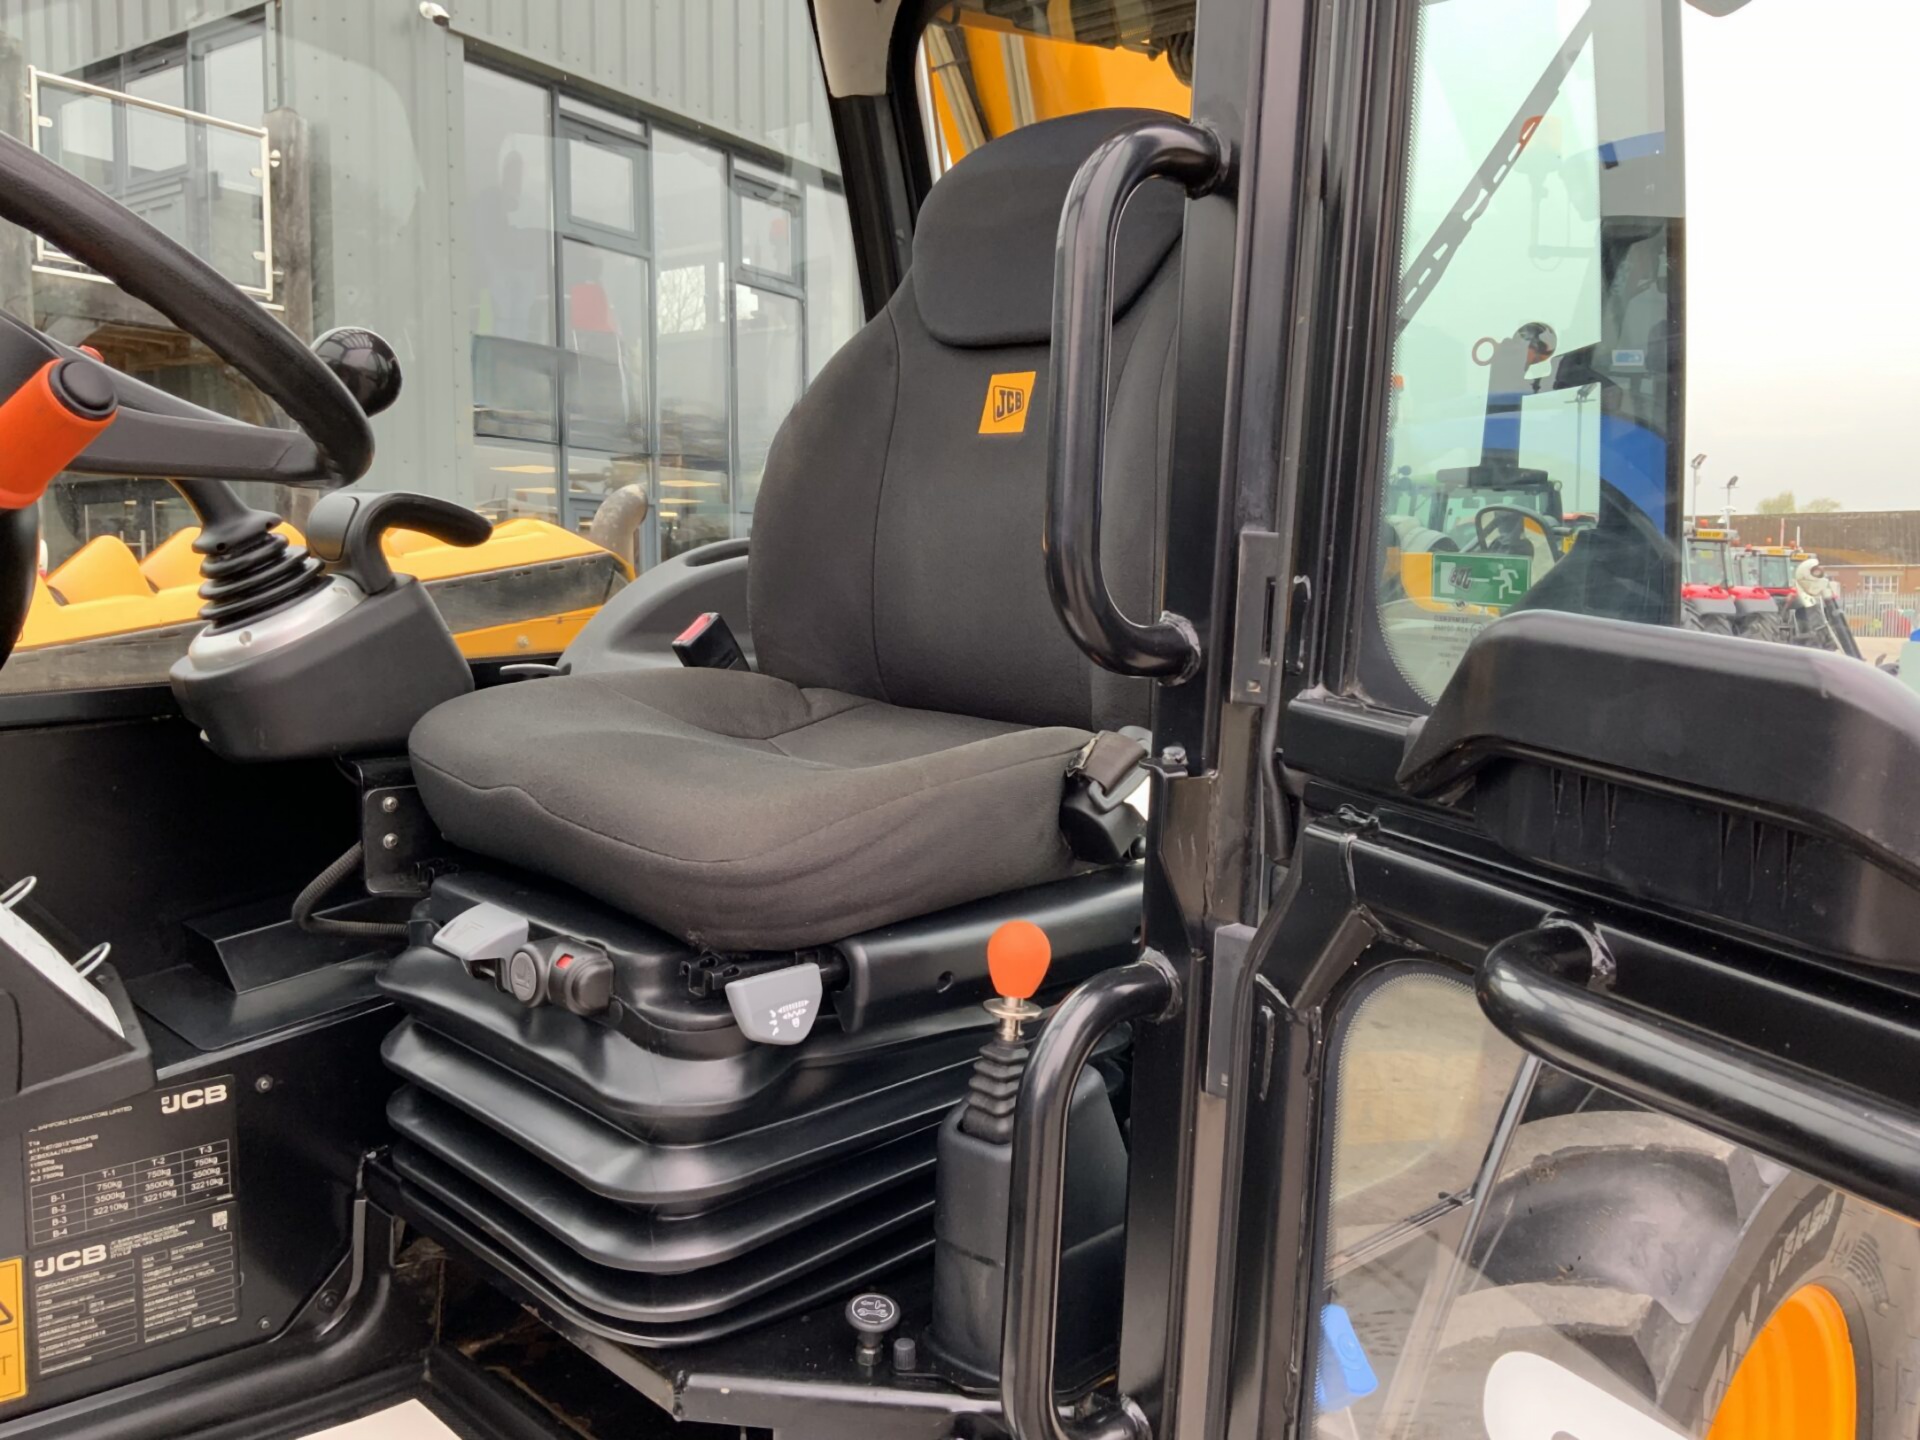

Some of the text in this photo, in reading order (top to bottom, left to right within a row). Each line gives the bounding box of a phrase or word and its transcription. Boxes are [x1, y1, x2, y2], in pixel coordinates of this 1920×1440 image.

[996, 389, 1022, 418] JCB
[161, 1084, 227, 1114] JCB
[199, 1145, 213, 1155] T-3
[152, 1157, 165, 1166] T-2
[195, 1156, 218, 1167] 750kg
[102, 1169, 116, 1178] T-1
[147, 1168, 171, 1179] 750kg
[192, 1167, 221, 1179] 3500kg
[97, 1181, 122, 1191] 750kg
[145, 1179, 174, 1191] 3500kg
[191, 1178, 224, 1191] 32210kg
[51, 1191, 126, 1204] B-1 3500kg
[143, 1190, 177, 1203] 32210kg
[51, 1202, 128, 1216] B-2 32210kg
[52, 1216, 67, 1226] B-3
[53, 1228, 68, 1238] B-4
[34, 1244, 107, 1277] JCB
